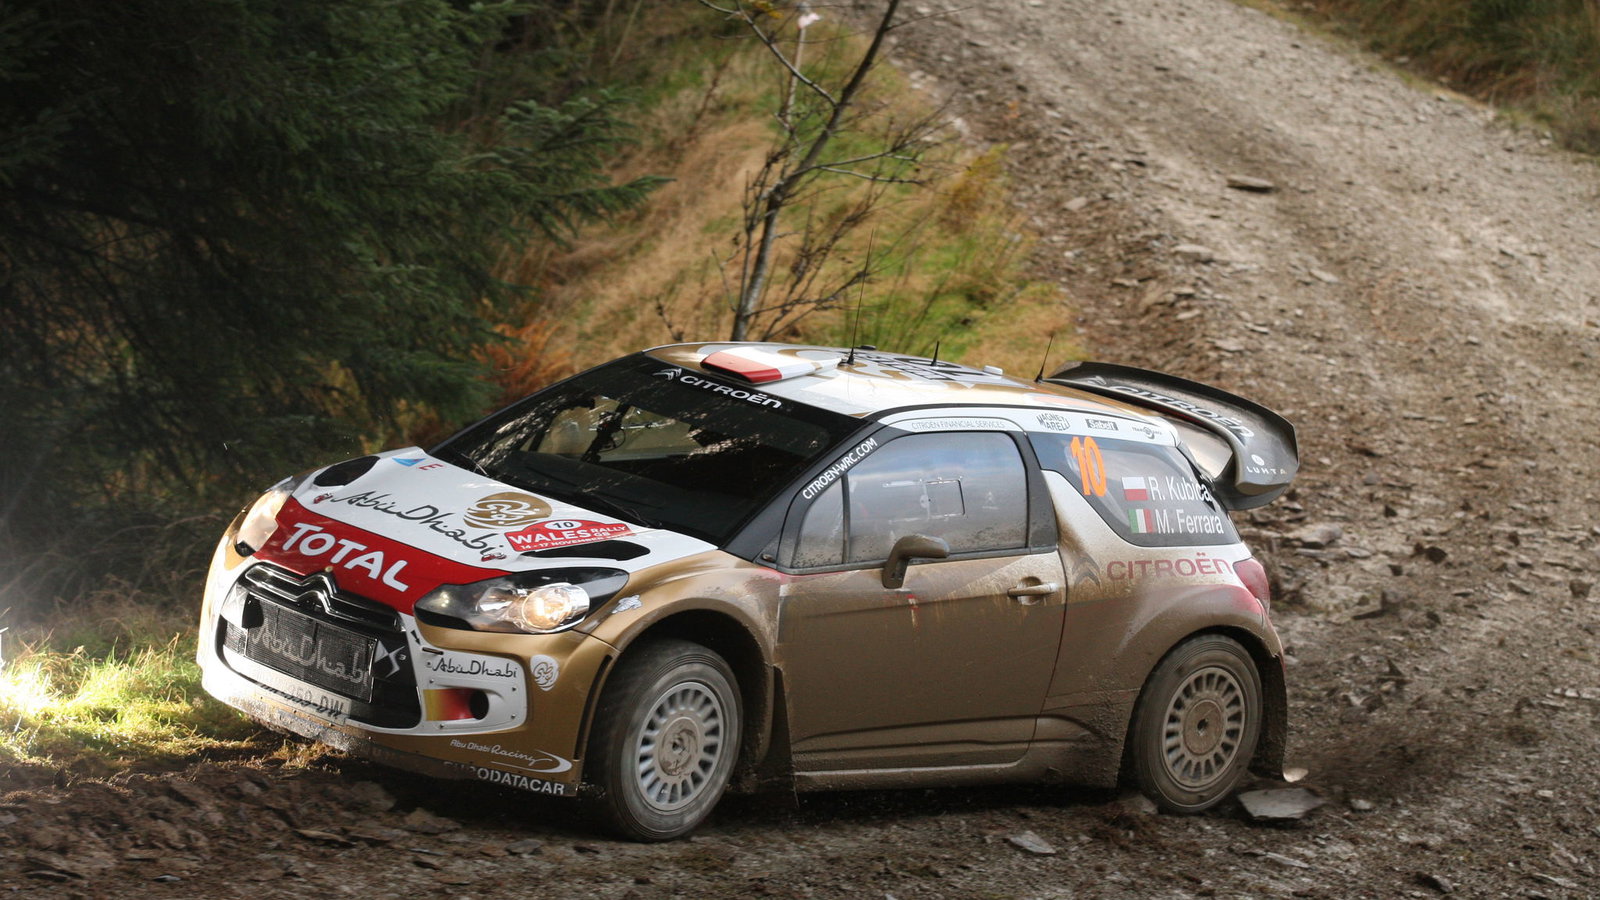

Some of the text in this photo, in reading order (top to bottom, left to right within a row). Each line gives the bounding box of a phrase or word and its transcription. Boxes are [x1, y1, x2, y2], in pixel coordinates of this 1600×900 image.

[802, 437, 878, 499] CITROEN-WRC.COM
[1070, 436, 1107, 497] 10
[1148, 475, 1213, 502] R. Kubica
[553, 521, 574, 529] 10
[1155, 508, 1225, 535] M. Ferrara
[508, 529, 592, 544] WALES
[281, 522, 409, 593] TOTAL
[450, 739, 467, 748] Abu
[467, 742, 491, 753] Dhabi
